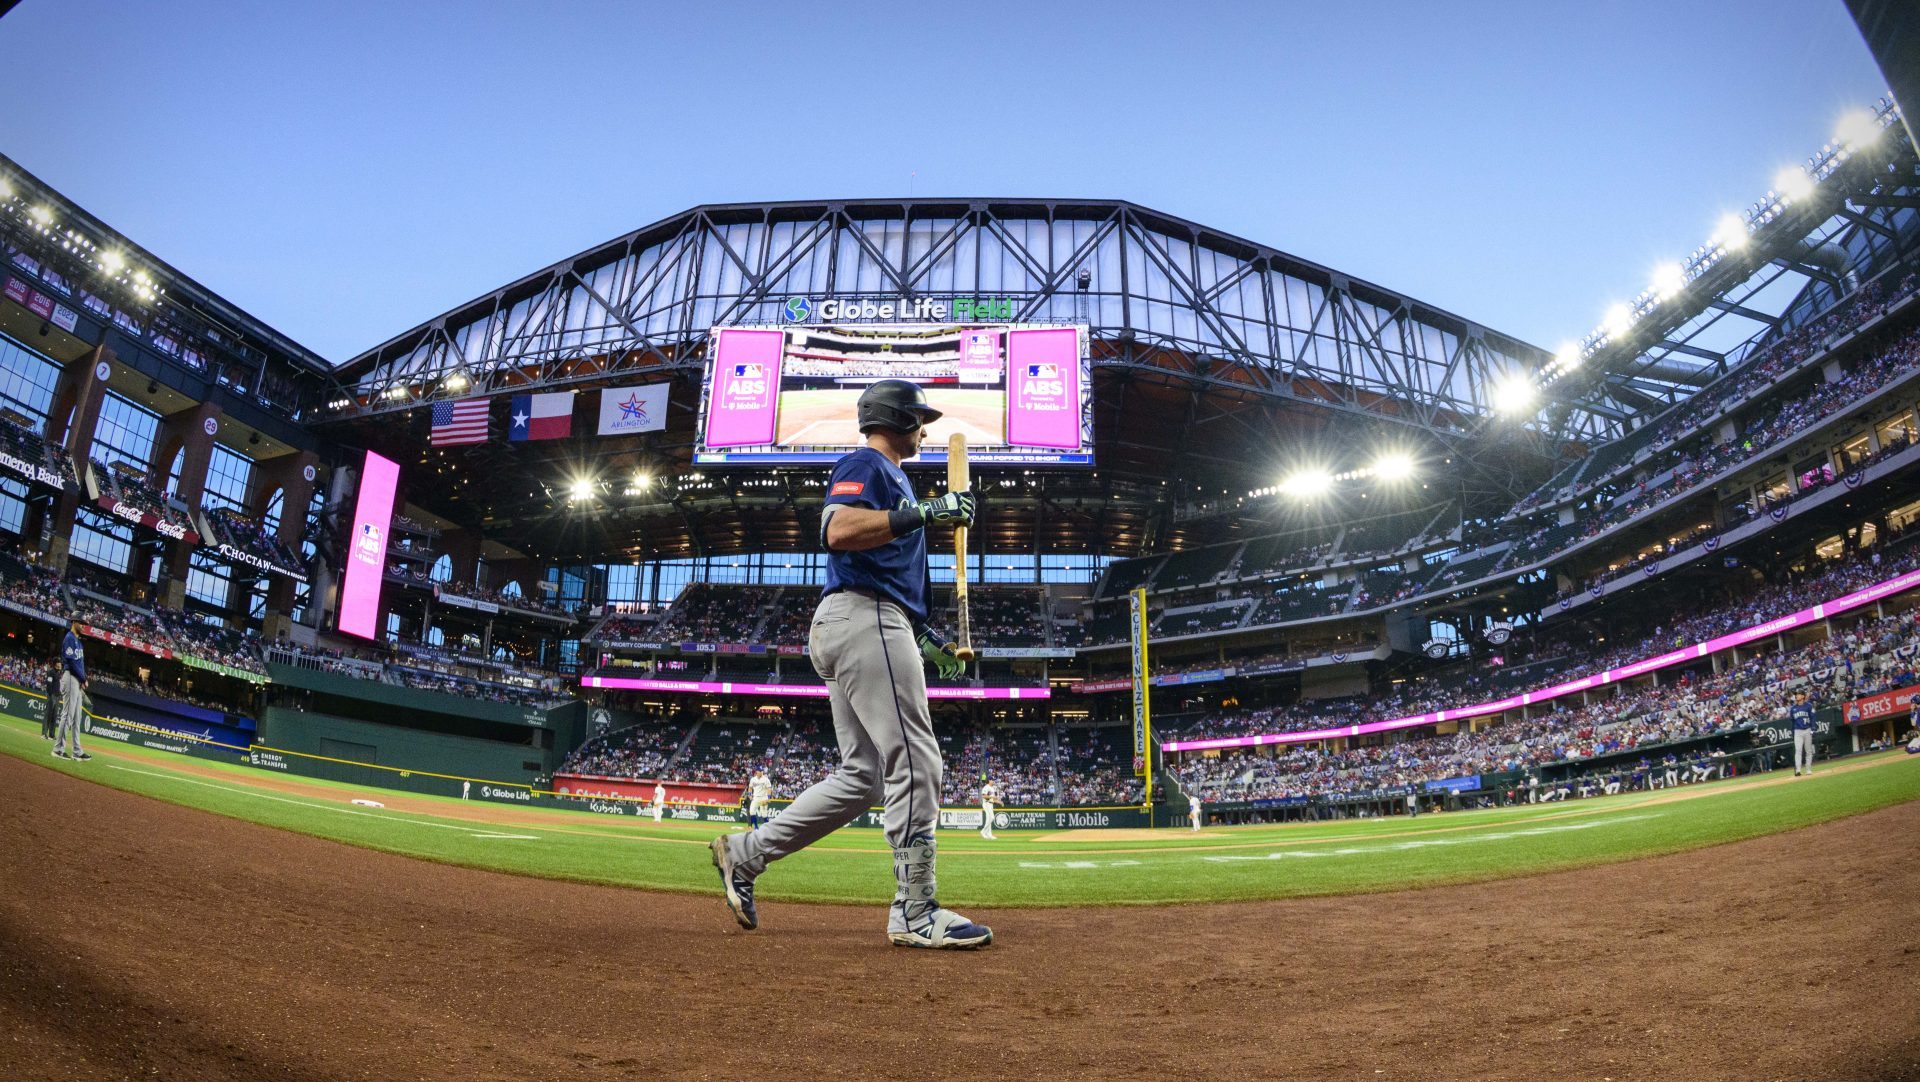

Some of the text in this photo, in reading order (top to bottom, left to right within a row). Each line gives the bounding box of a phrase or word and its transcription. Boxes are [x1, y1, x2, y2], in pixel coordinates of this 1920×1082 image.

[819, 297, 1012, 320] Globe Life Field
[728, 380, 765, 395] ABS
[1022, 380, 1063, 396] ABS
[205, 420, 217, 432] 29
[611, 418, 651, 429] ARLINGTON
[37, 467, 66, 490] Bank
[224, 545, 272, 571] CHOCTAW
[1132, 613, 1141, 675] CHIKIN
[223, 666, 264, 684] STAFFING
[1863, 697, 1891, 716] SPEC'S
[91, 726, 131, 741] PROGRESSIVE
[1136, 707, 1144, 752] FARE
[261, 752, 283, 762] ENERGY
[261, 759, 287, 770] TRANSFER
[492, 788, 530, 801] Globe Life
[590, 802, 624, 815] Kubota
[707, 814, 735, 822] HONDA
[1069, 813, 1109, 827] Mobile
